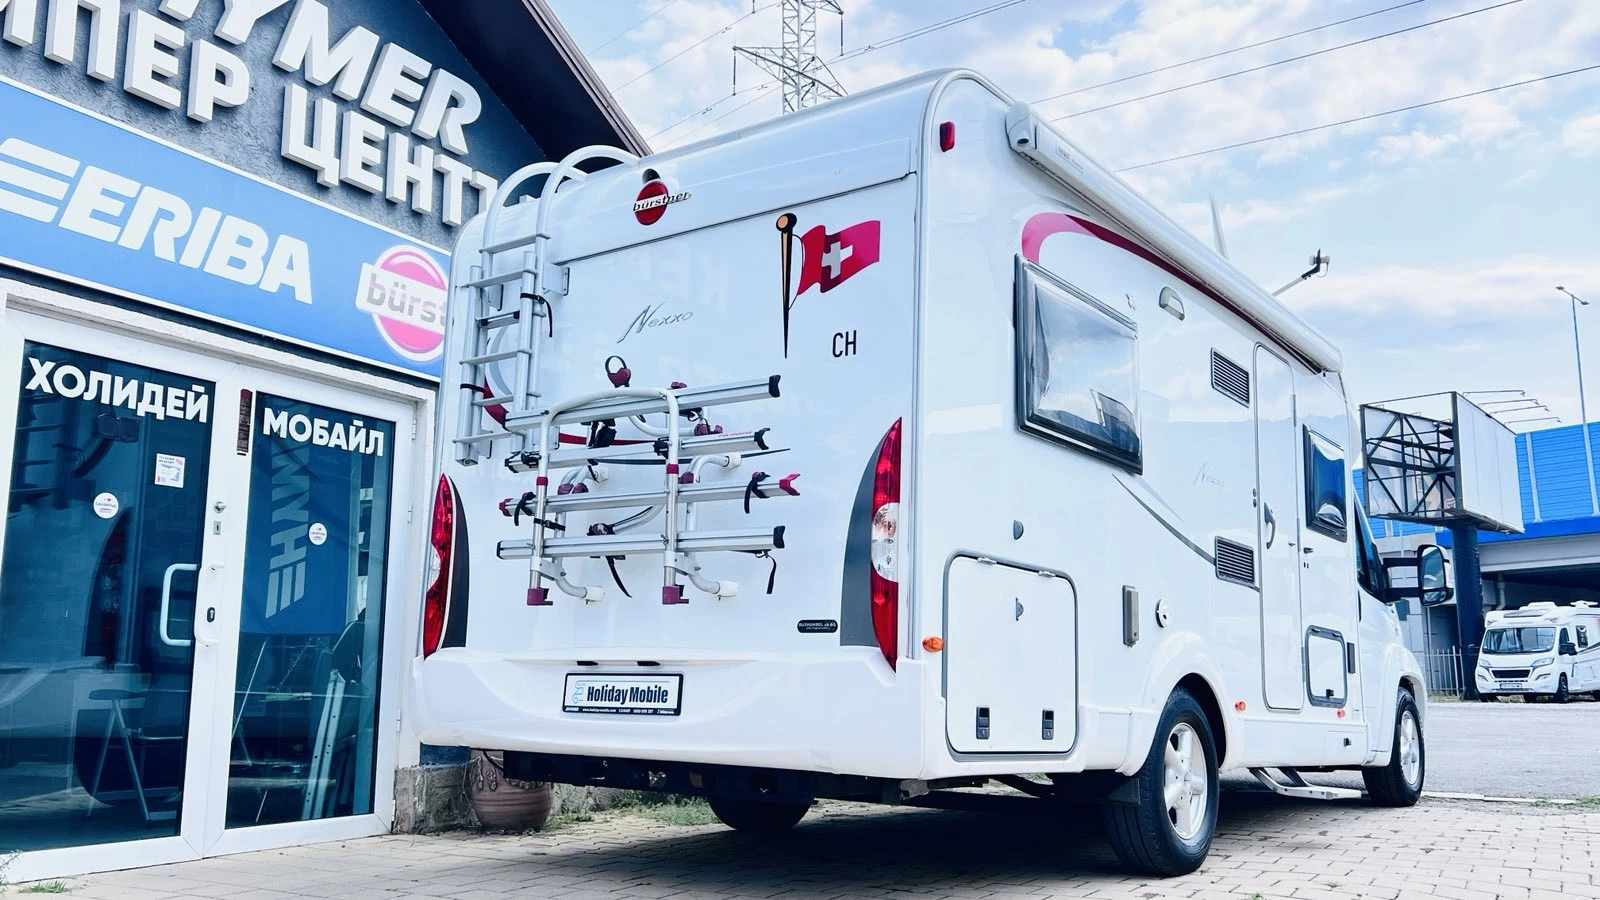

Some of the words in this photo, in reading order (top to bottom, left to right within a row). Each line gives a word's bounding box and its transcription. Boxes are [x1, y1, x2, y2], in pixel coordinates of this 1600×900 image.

[159, 0, 482, 156] YMER
[633, 191, 689, 212] bürstner
[58, 165, 313, 304] ERIBA
[617, 301, 694, 344] Nexxo
[832, 330, 857, 358] CH
[25, 357, 209, 423] ХОЛИДЕЙ
[263, 408, 385, 457] МОБАЙЛ
[587, 684, 628, 705] Holiday
[629, 685, 669, 704] Mobile
